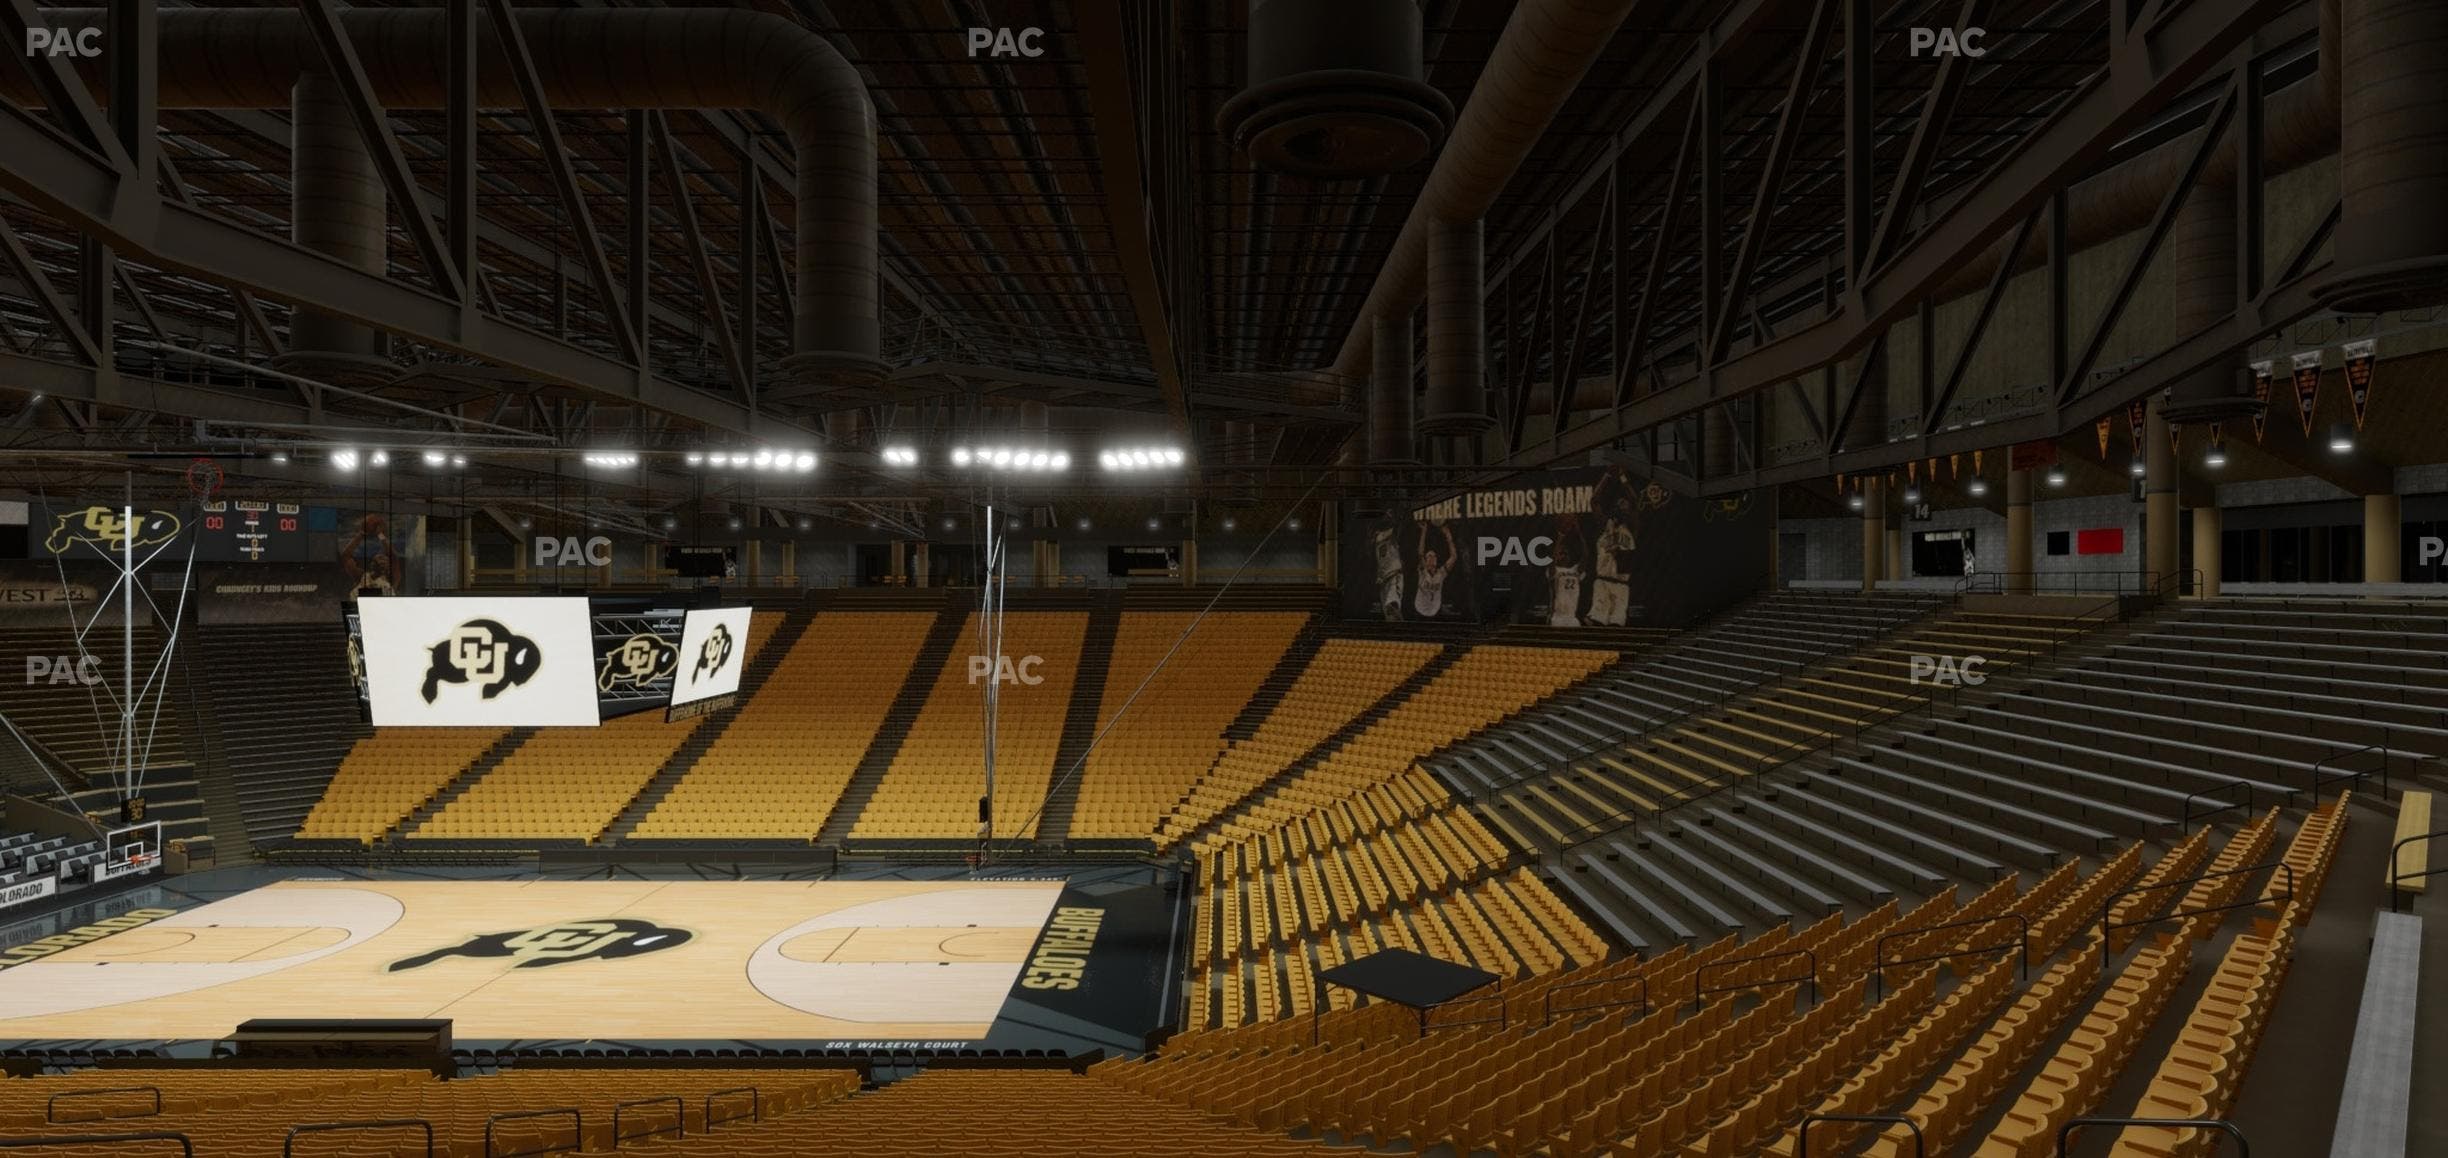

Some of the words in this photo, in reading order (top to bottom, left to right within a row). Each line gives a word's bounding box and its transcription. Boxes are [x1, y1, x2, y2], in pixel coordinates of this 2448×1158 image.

[1465, 489, 1537, 518] LEGENDS
[1541, 485, 1594, 515] ROAM
[1914, 503, 1929, 519] 14
[449, 626, 509, 685] CU
[1021, 906, 1105, 991] BUFFALOES
[826, 1041, 852, 1049] SOX
[857, 1041, 919, 1049] WALSETH
[924, 1041, 968, 1049] COURT
